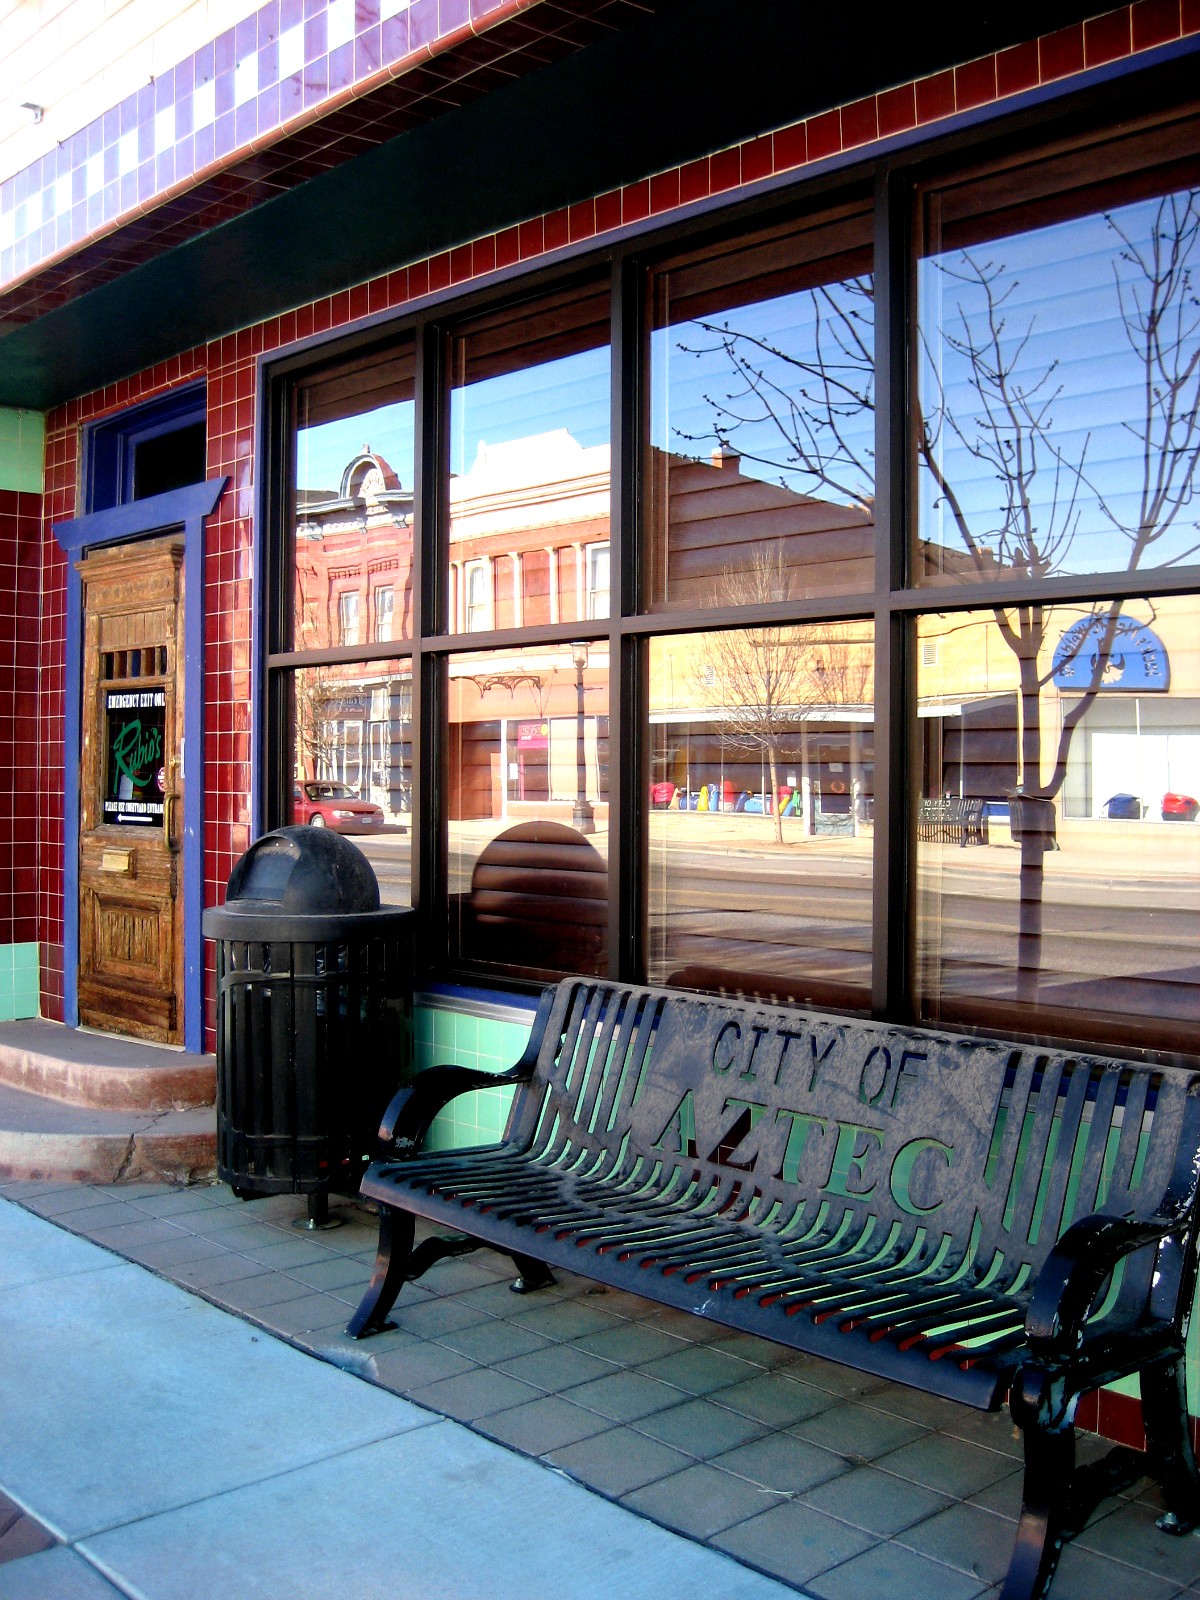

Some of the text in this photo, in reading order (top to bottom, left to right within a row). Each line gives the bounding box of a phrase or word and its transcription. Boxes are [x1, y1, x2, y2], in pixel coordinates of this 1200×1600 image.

[108, 692, 165, 709] EMERGENCY EXIT ONL
[112, 719, 161, 795] Rubio's
[712, 1021, 928, 1109] CITY OF
[650, 1088, 954, 1216] AZTEC
